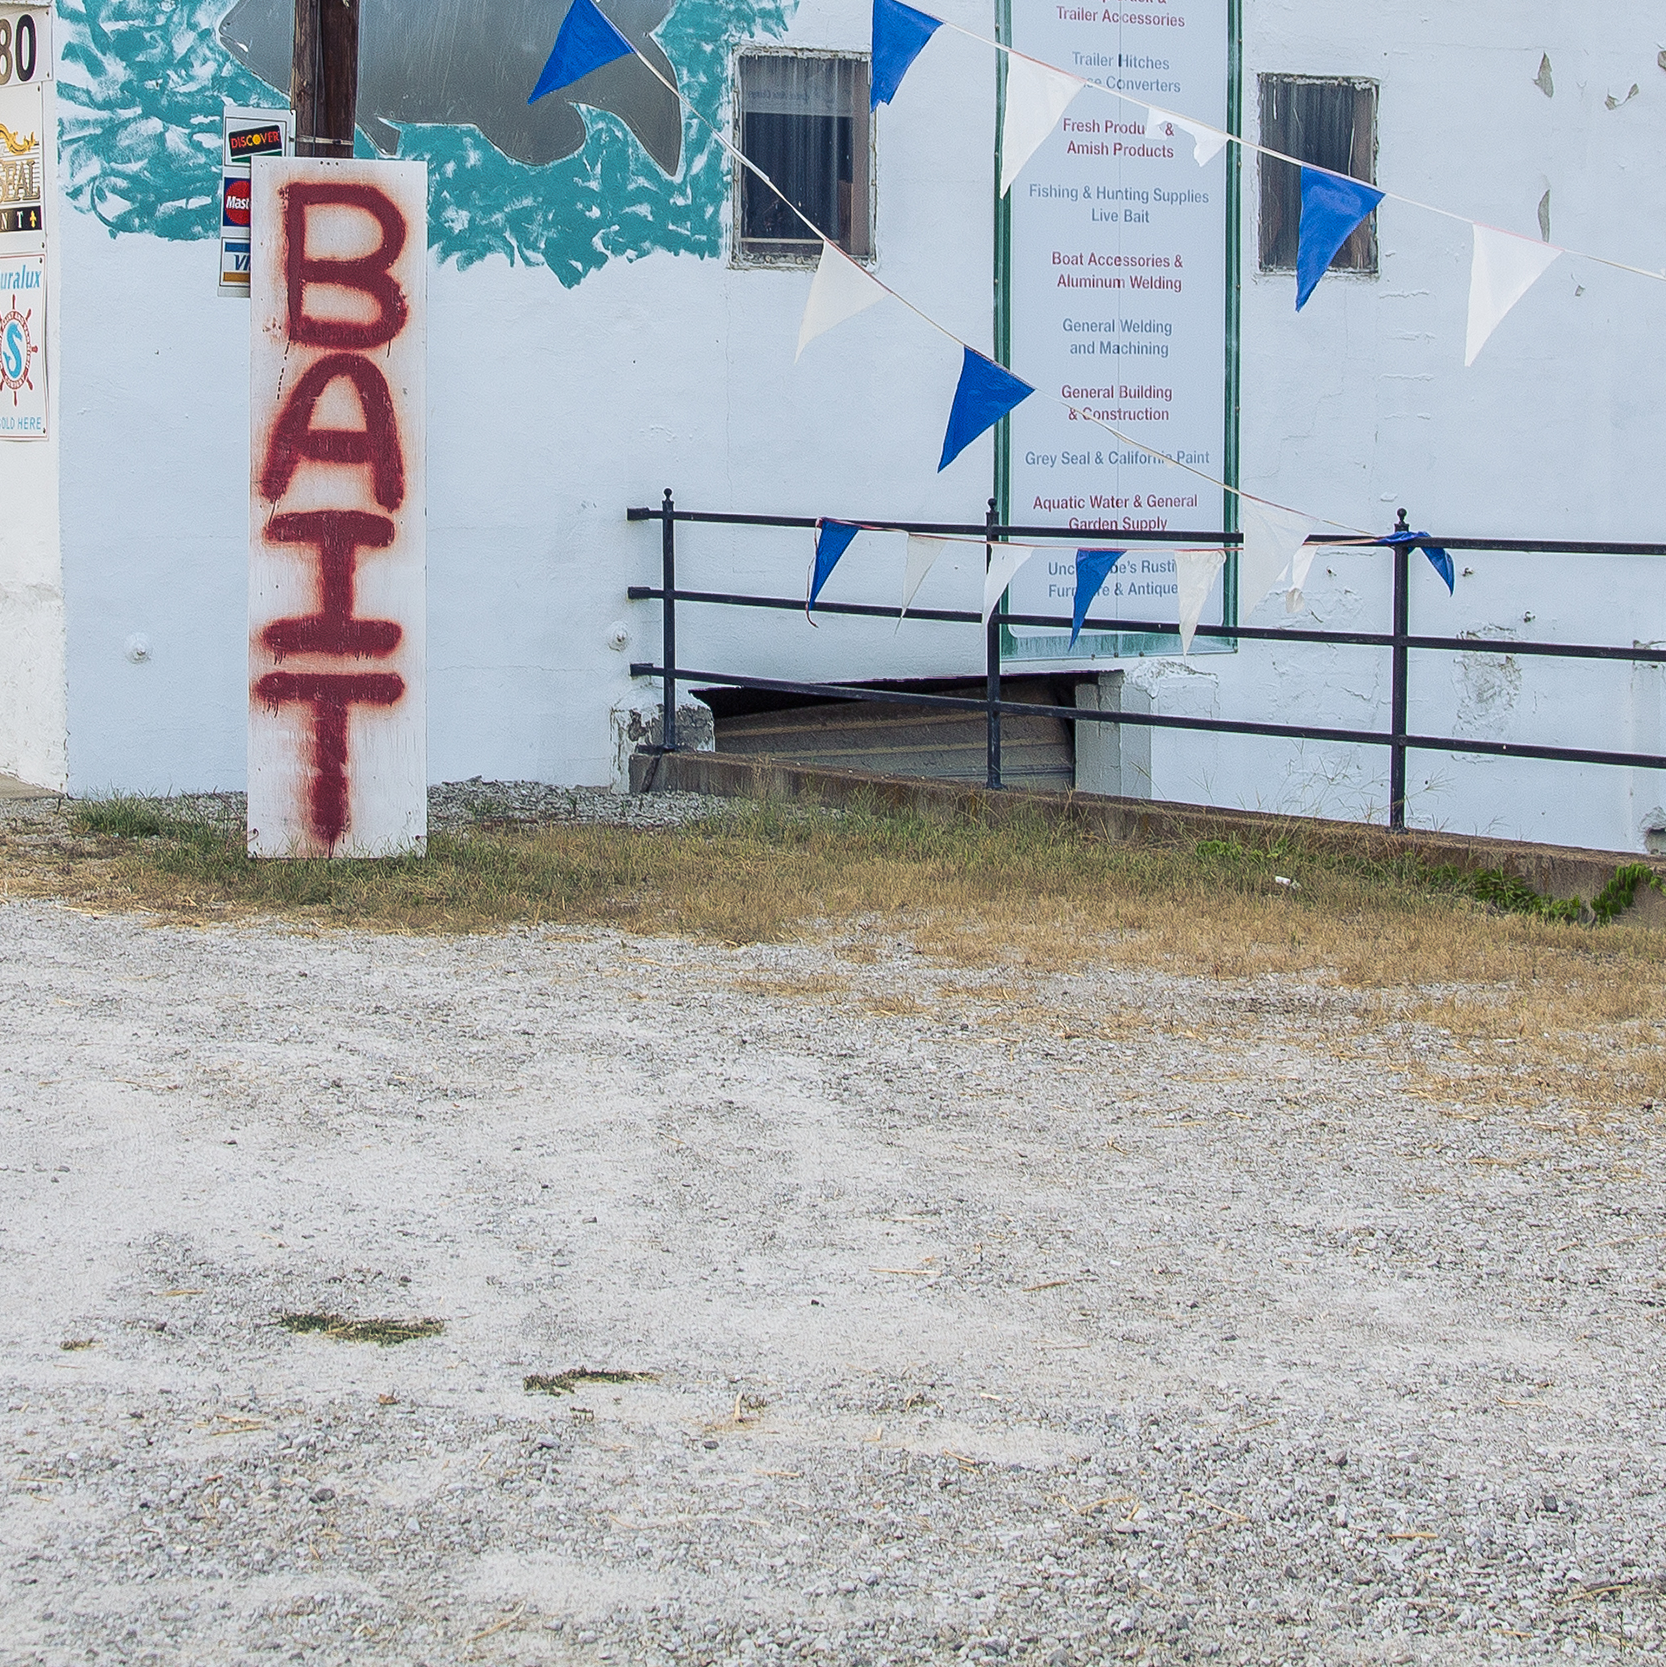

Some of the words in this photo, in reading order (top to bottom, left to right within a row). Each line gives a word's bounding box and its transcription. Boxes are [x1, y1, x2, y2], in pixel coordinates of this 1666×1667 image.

[1056, 5, 1098, 22] Trailer
[1101, 8, 1185, 27] Accessories
[1072, 51, 1113, 67] Trailer
[1118, 53, 1170, 71] Hitches
[1106, 75, 1181, 93] Converters
[1063, 117, 1100, 133] Fresh
[1105, 120, 1145, 135] Produ
[1165, 122, 1175, 136] &
[230, 131, 280, 149] DISCOVER
[1067, 140, 1109, 156] Amish
[1113, 142, 1174, 159] Products
[1029, 184, 1079, 202] Fishing
[1082, 185, 1092, 200] &
[1096, 186, 1149, 204] Hunting
[1153, 187, 1210, 206] Supplies
[1091, 208, 1119, 222] Live
[1123, 209, 1150, 223] Bait
[1051, 251, 1084, 267] Boat
[1088, 252, 1170, 268] Accessories
[1174, 254, 1184, 268] &
[1057, 274, 1125, 289] Aluminum
[1129, 275, 1182, 293] Welding
[1062, 318, 1115, 333] General
[1119, 319, 1173, 336] Welding
[1070, 341, 1095, 355] and
[1099, 341, 1169, 358] Machining
[1061, 385, 1114, 400] General
[1119, 385, 1173, 402] Building
[18, 416, 42, 430] HERE
[1068, 407, 1078, 421] &
[1082, 407, 1169, 421] Construction
[1025, 450, 1057, 468] Grey
[1061, 451, 1090, 465] Seal
[1094, 451, 1104, 465] &
[1177, 450, 1210, 465] Paint
[1033, 495, 1085, 512] Aquatic
[1090, 495, 1130, 509] Water
[1133, 494, 1143, 508] &
[1146, 493, 1198, 508] General
[255, 181, 407, 843] BAIT
[1068, 516, 1118, 530] Garden
[1122, 516, 1168, 531] Supply
[1048, 562, 1075, 576] Unc
[1141, 559, 1176, 573] Rusti
[1114, 582, 1124, 596] &
[1128, 581, 1179, 598] Antique
